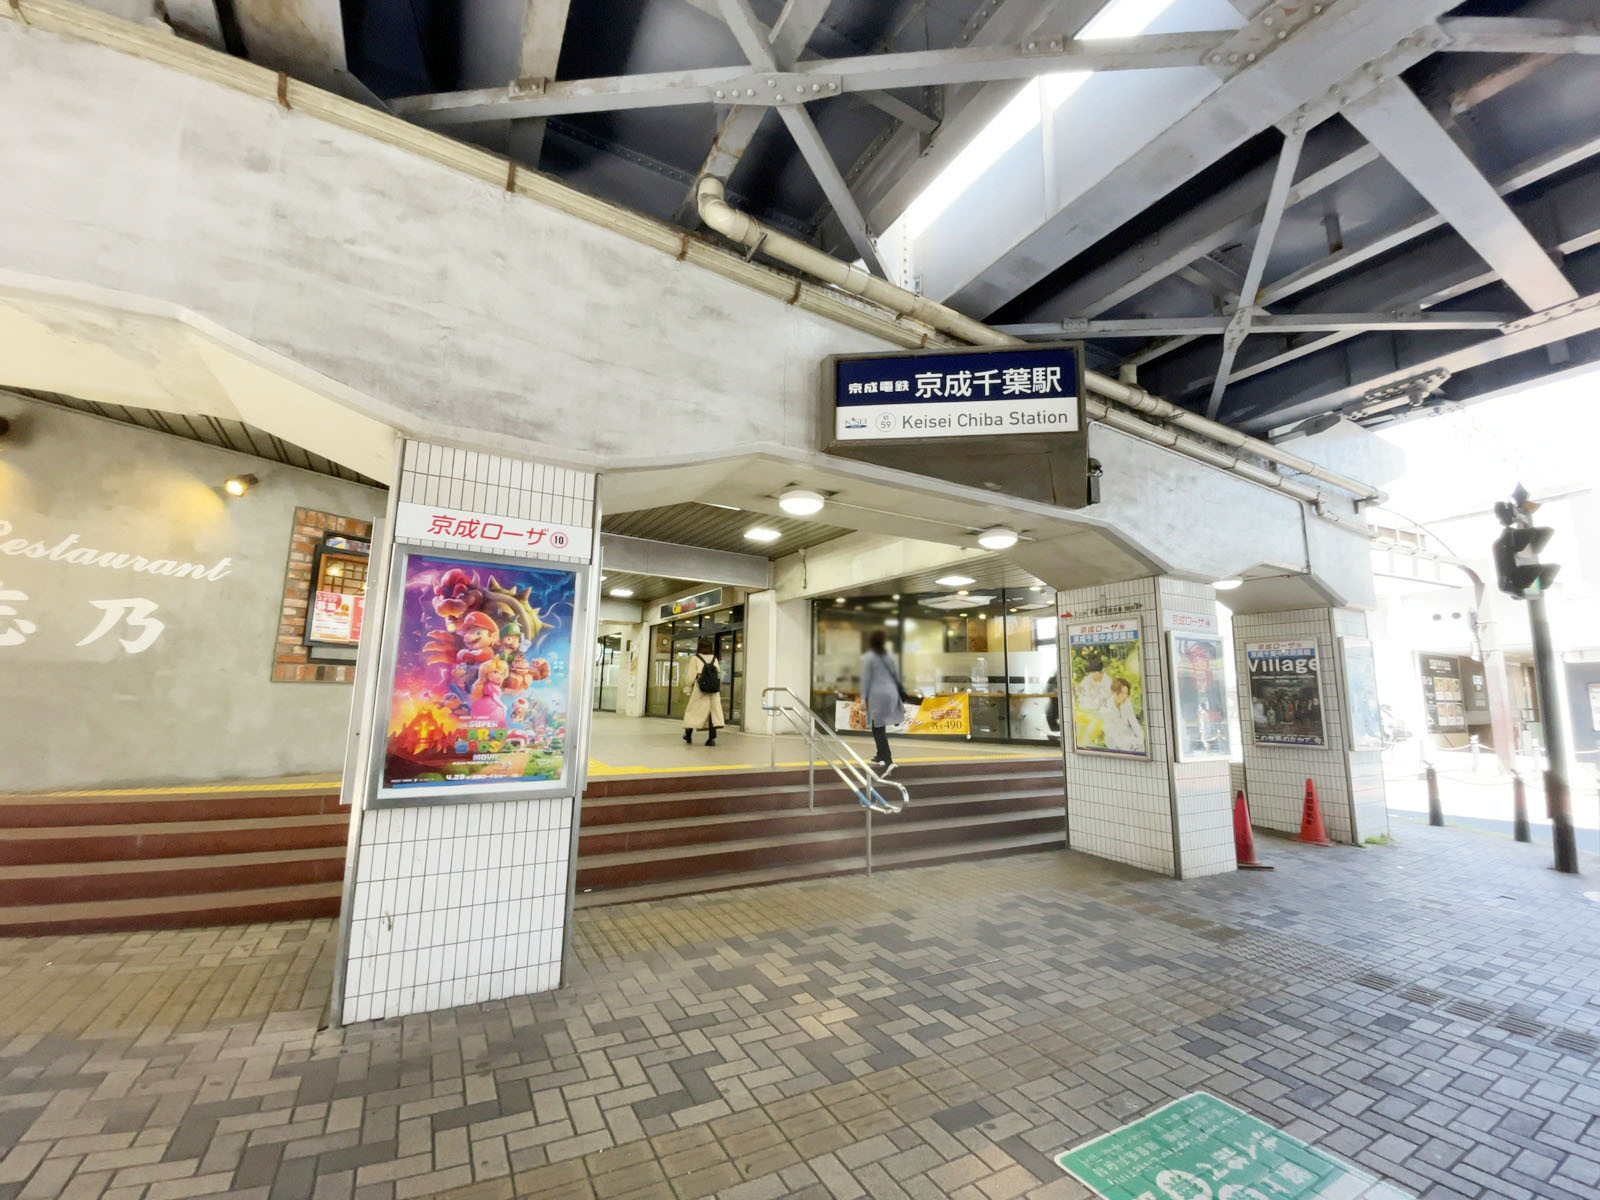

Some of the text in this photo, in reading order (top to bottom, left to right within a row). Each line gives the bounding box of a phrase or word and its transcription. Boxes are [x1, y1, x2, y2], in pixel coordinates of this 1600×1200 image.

[848, 366, 1063, 398] 京成電鉄 京成千葉駅
[880, 420, 892, 429] 59
[902, 410, 1069, 430] Keisei Chiba Station
[427, 515, 550, 546] 京成ローザ
[1248, 657, 1318, 674] Village
